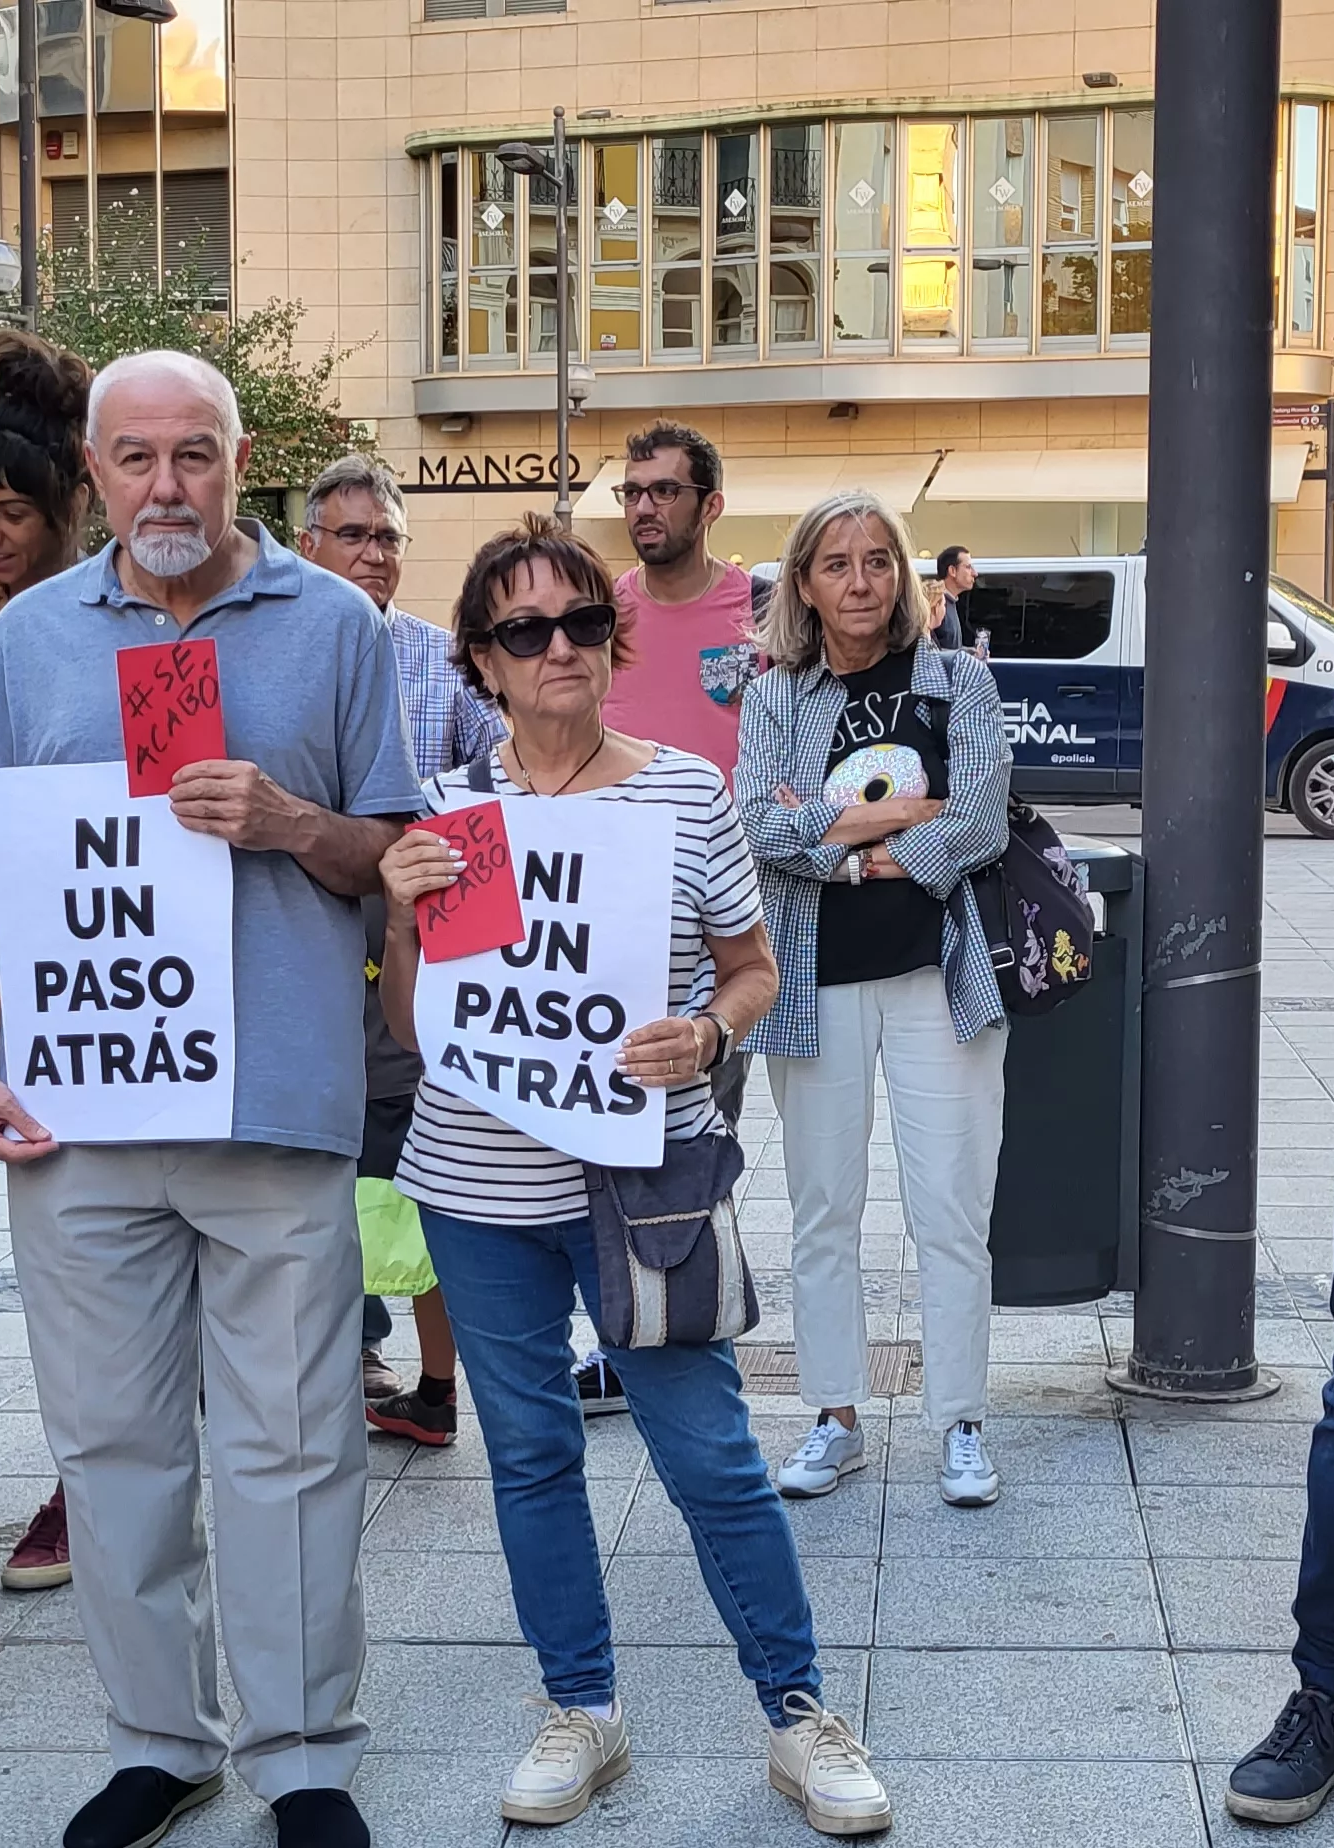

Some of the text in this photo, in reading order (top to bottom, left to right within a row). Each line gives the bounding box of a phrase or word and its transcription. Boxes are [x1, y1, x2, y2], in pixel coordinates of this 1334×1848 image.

[419, 453, 580, 485] MANGO
[75, 815, 140, 869] NI
[522, 849, 583, 904] NI
[64, 885, 155, 939] UN
[501, 919, 590, 974] UN
[34, 955, 194, 1012] PASO
[454, 981, 626, 1045] PASO
[24, 1015, 218, 1086] ATRÁS
[440, 1043, 647, 1116] ATRÁS
